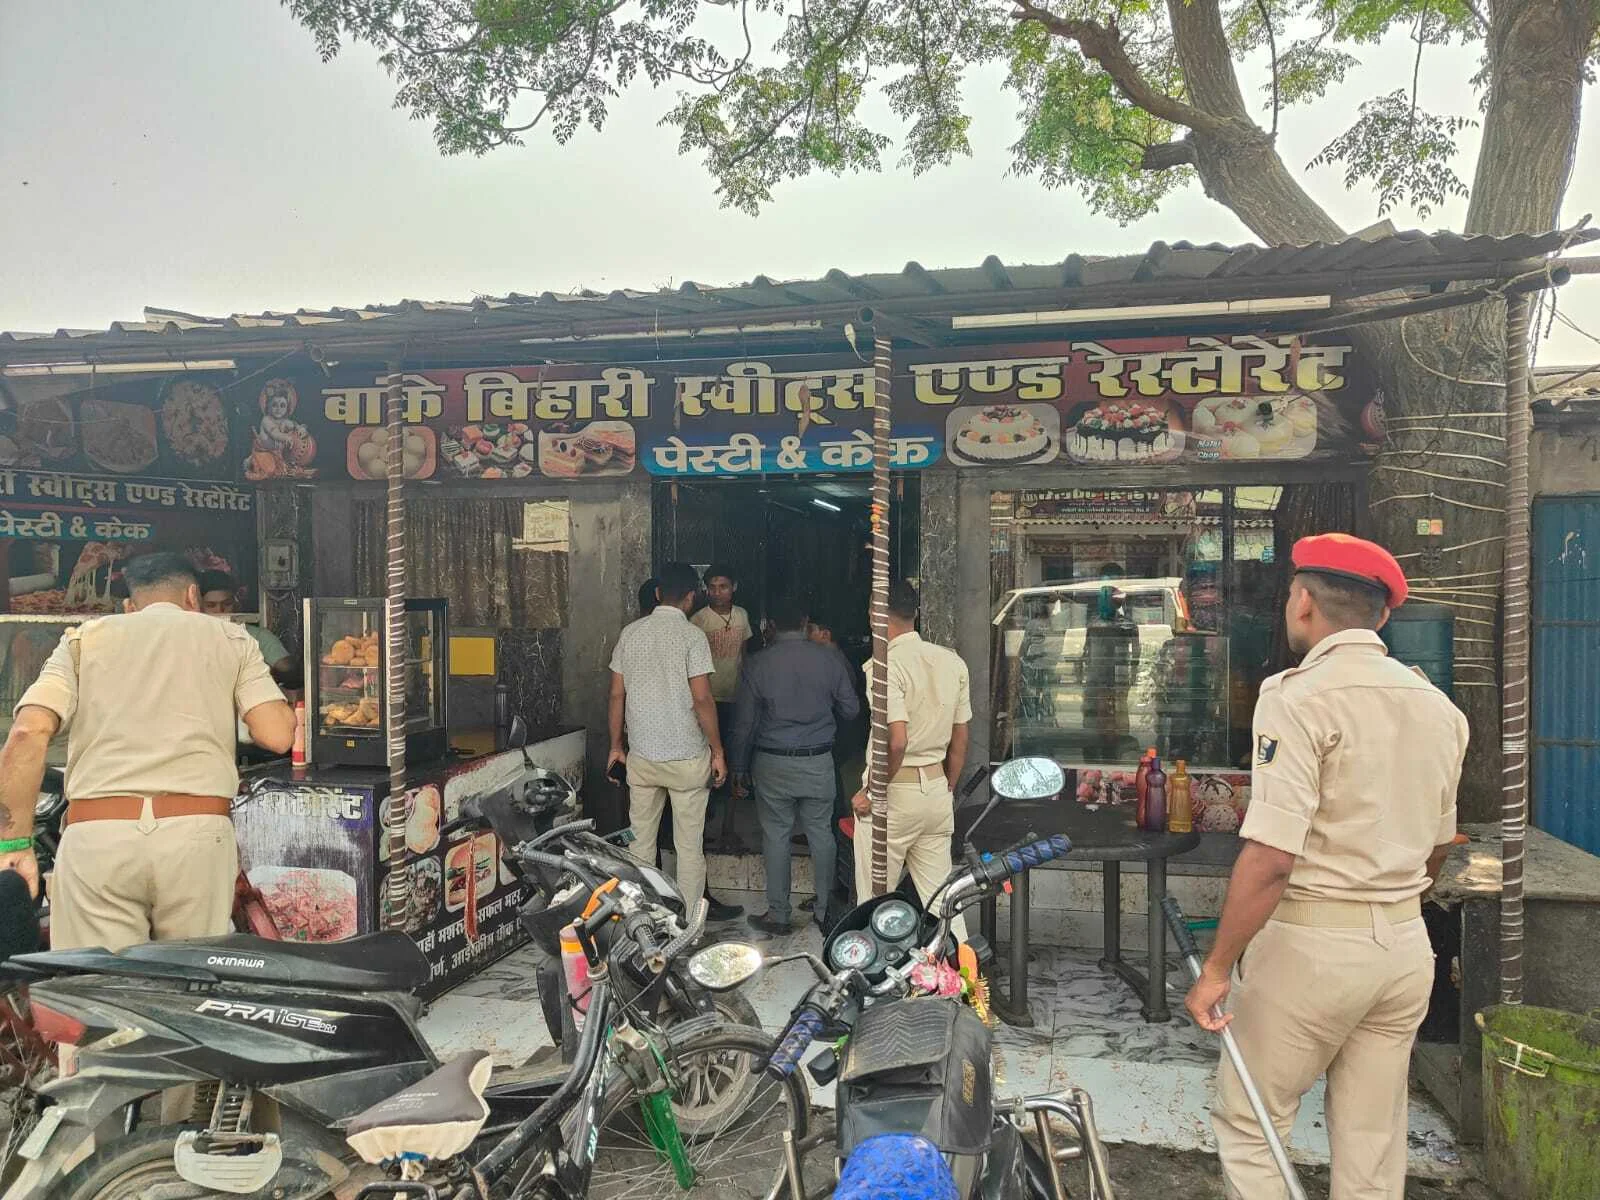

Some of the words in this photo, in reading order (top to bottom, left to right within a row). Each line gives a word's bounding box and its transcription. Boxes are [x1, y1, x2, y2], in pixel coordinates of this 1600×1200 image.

[463, 367, 656, 421] बिहारी
[908, 356, 1069, 405] एण्ड
[652, 433, 767, 473] पेस्टी
[776, 435, 808, 470] &
[819, 429, 935, 466] केक
[124, 482, 177, 506] एण्ड
[70, 515, 88, 538] &
[94, 516, 151, 539] केक
[207, 956, 265, 969] OKINAWA
[194, 999, 322, 1032] PRAISE
